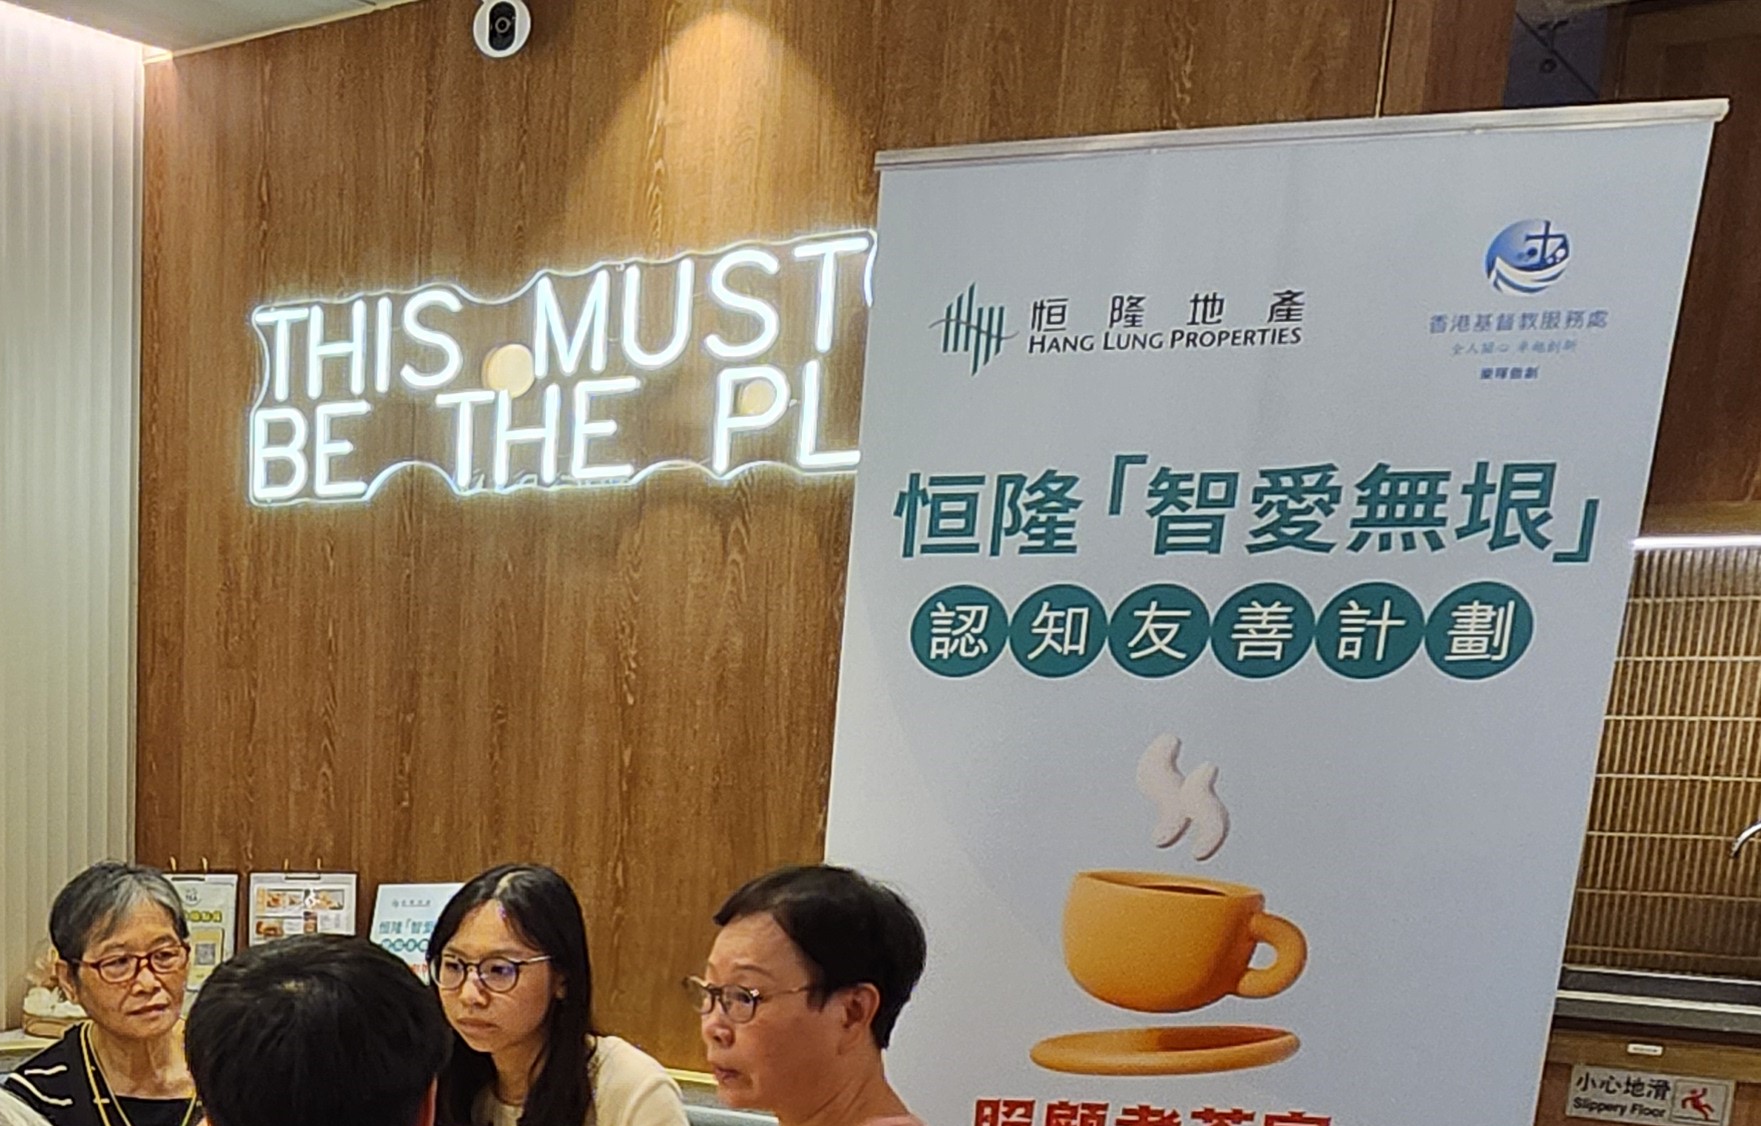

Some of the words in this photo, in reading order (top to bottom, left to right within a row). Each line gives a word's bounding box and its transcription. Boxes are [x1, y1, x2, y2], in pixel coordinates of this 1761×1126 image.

[255, 290, 463, 401] THIS
[533, 238, 870, 380] MUST
[1031, 289, 1305, 332] 恒隆地產
[1028, 333, 1095, 354] HANG
[1102, 330, 1164, 351] LUNG
[1169, 326, 1303, 349] PROPERTIES
[253, 401, 371, 500] BE
[435, 376, 642, 487] THE
[894, 453, 1601, 564] 恒隆「智愛無垠」
[928, 599, 1517, 664] 認知友善計劃
[1572, 1096, 1628, 1116] Slippery
[1629, 1103, 1666, 1118] Floor
[1575, 1072, 1671, 1100] 小心地滑
